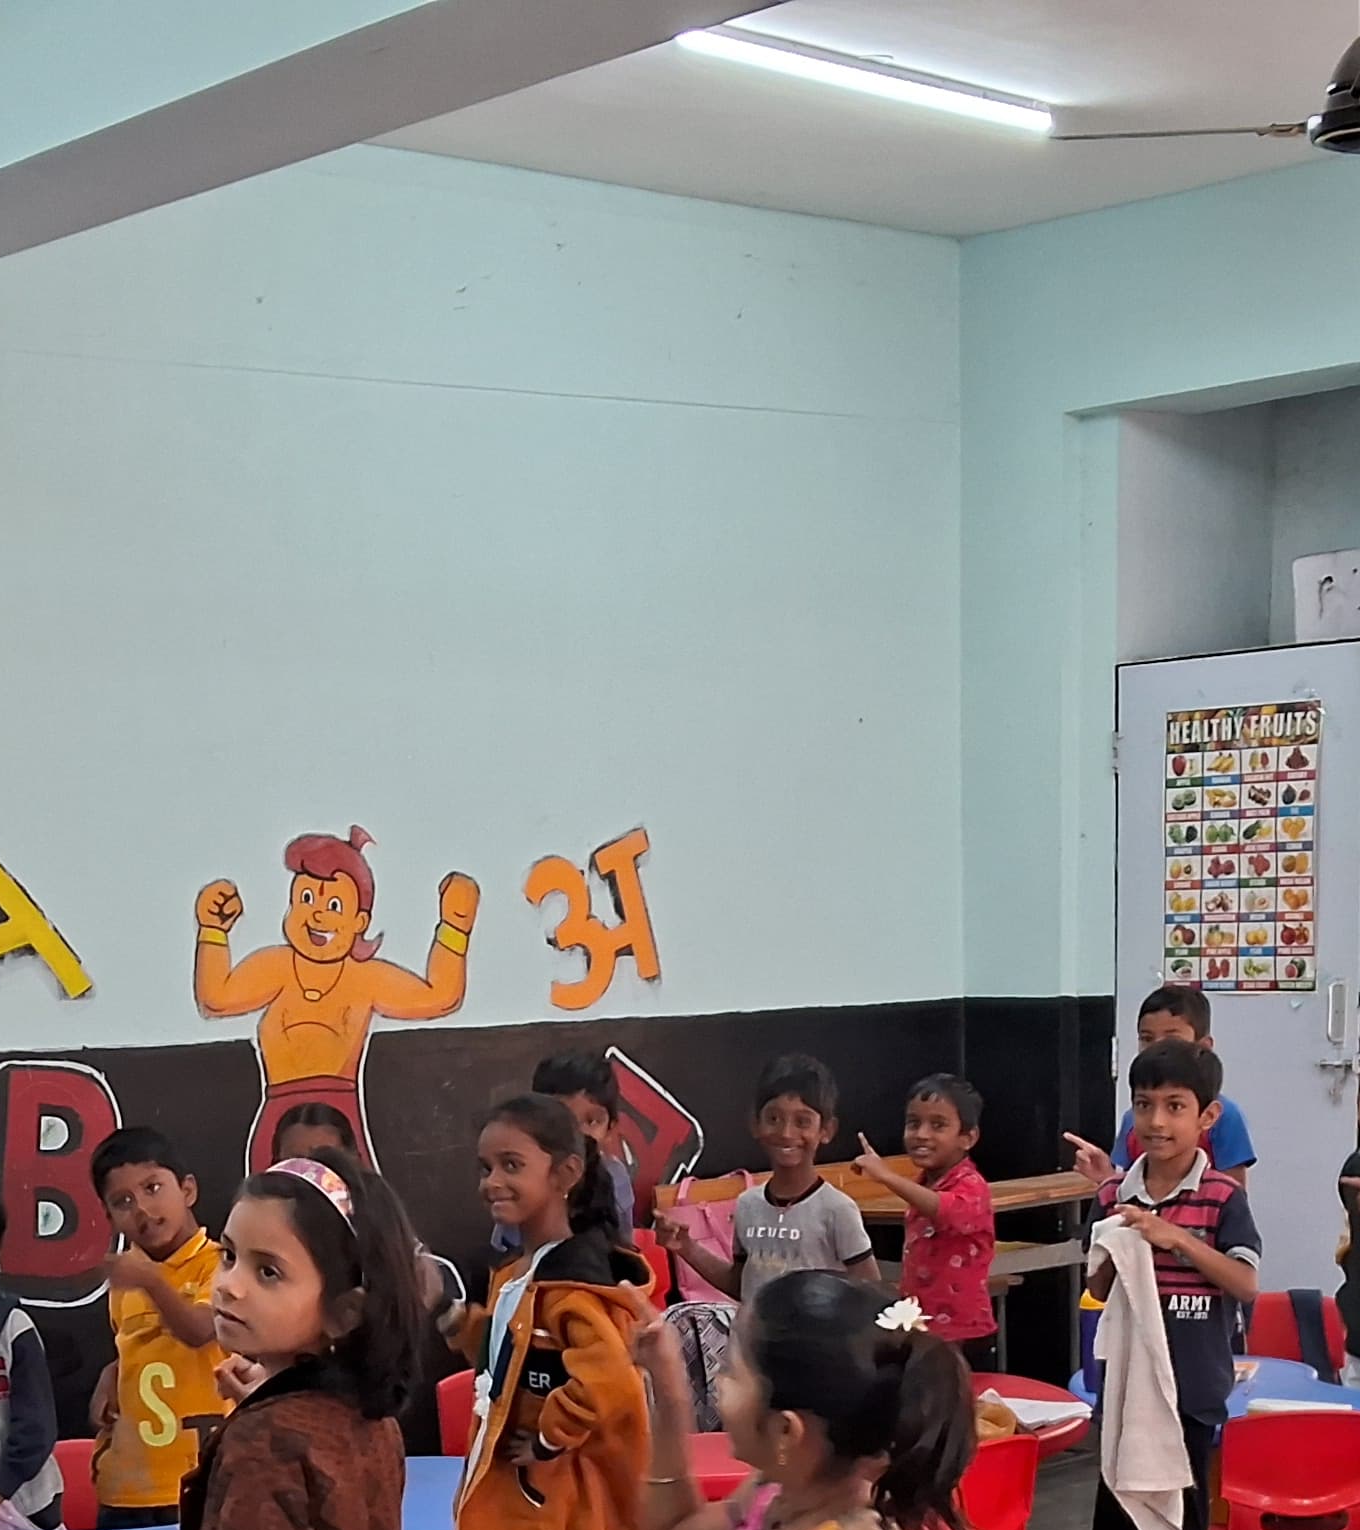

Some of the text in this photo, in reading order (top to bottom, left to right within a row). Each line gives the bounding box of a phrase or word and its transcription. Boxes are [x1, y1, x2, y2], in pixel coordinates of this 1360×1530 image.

[1170, 710, 1317, 745] HEALTHY FRUITS
[524, 825, 660, 1010] अ
[1167, 1294, 1212, 1312] ARMY
[528, 1370, 552, 1389] ER
[138, 1361, 178, 1448] S
